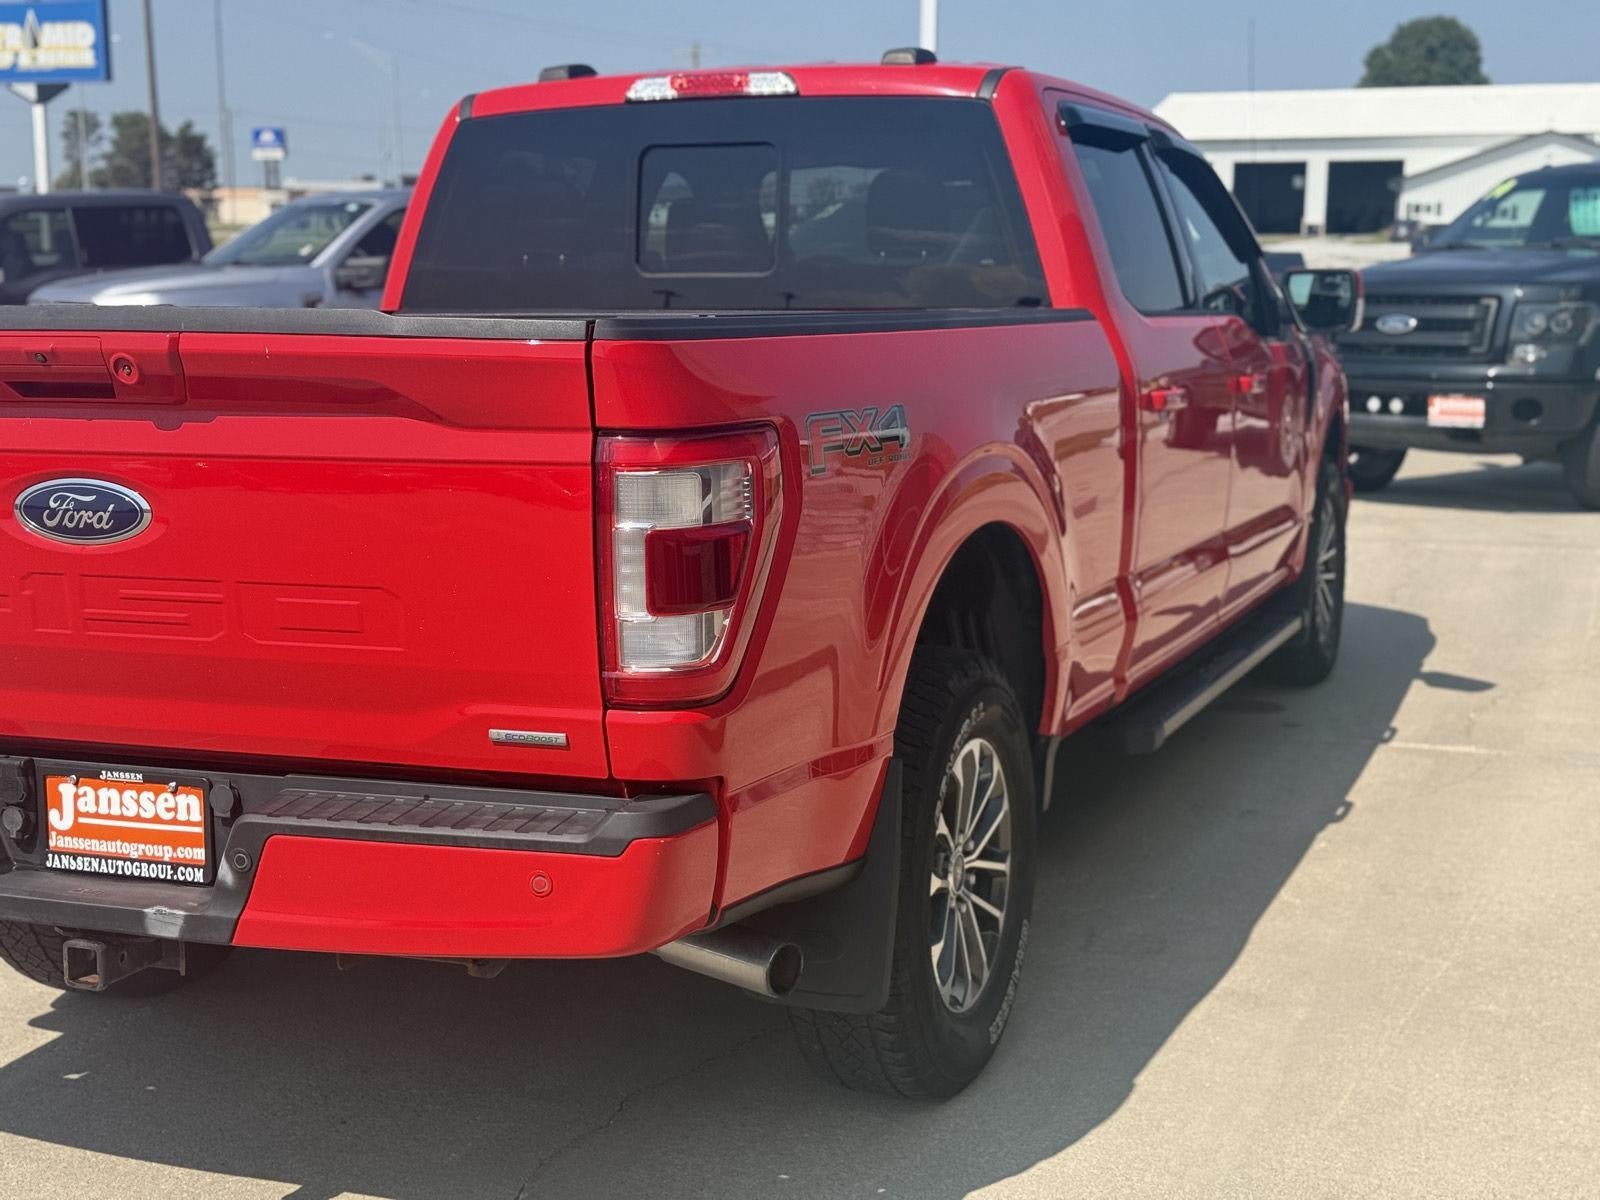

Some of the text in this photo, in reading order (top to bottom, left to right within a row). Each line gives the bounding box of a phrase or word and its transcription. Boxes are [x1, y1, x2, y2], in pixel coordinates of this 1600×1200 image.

[805, 403, 911, 477] FX4
[42, 492, 115, 530] Ford
[99, 770, 143, 781] JANSSEN
[49, 783, 202, 831] Janssen
[48, 830, 205, 861] Janssenautogroup.com
